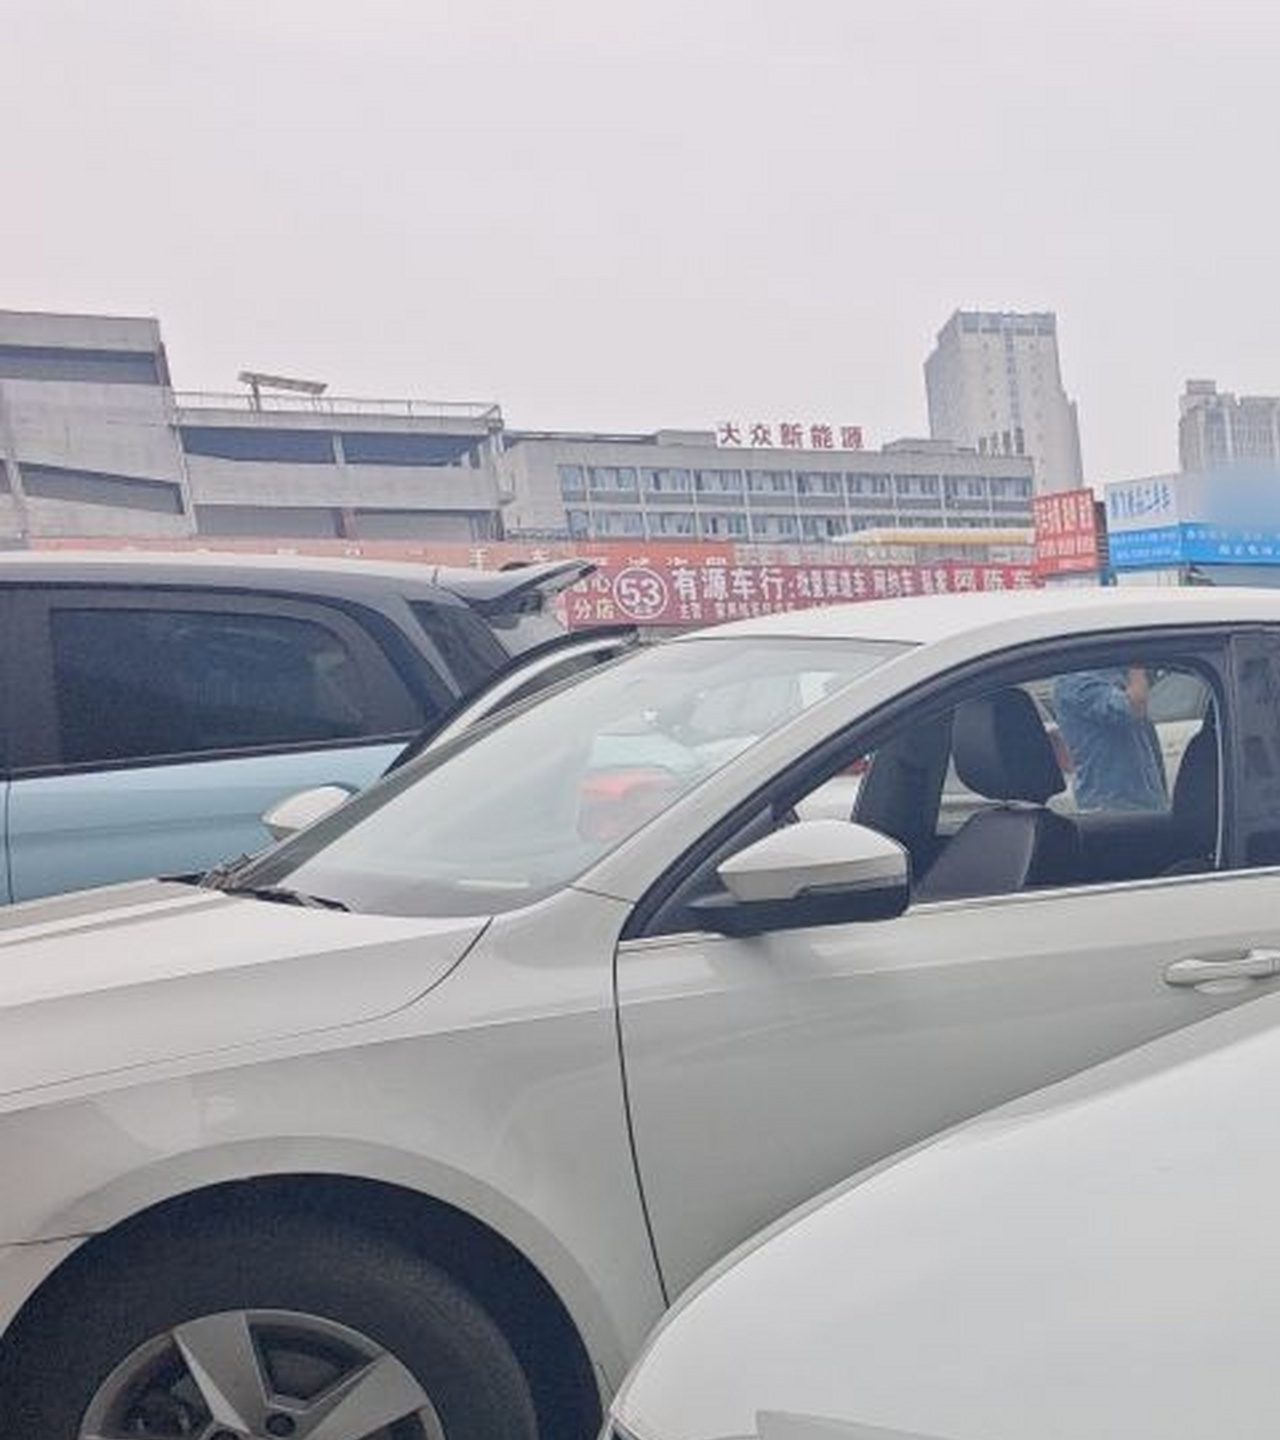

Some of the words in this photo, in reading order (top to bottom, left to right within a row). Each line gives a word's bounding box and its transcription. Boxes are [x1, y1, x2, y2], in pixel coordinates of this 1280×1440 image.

[719, 422, 864, 448] 大众新能源
[620, 579, 661, 606] 53
[574, 600, 614, 619] 分店
